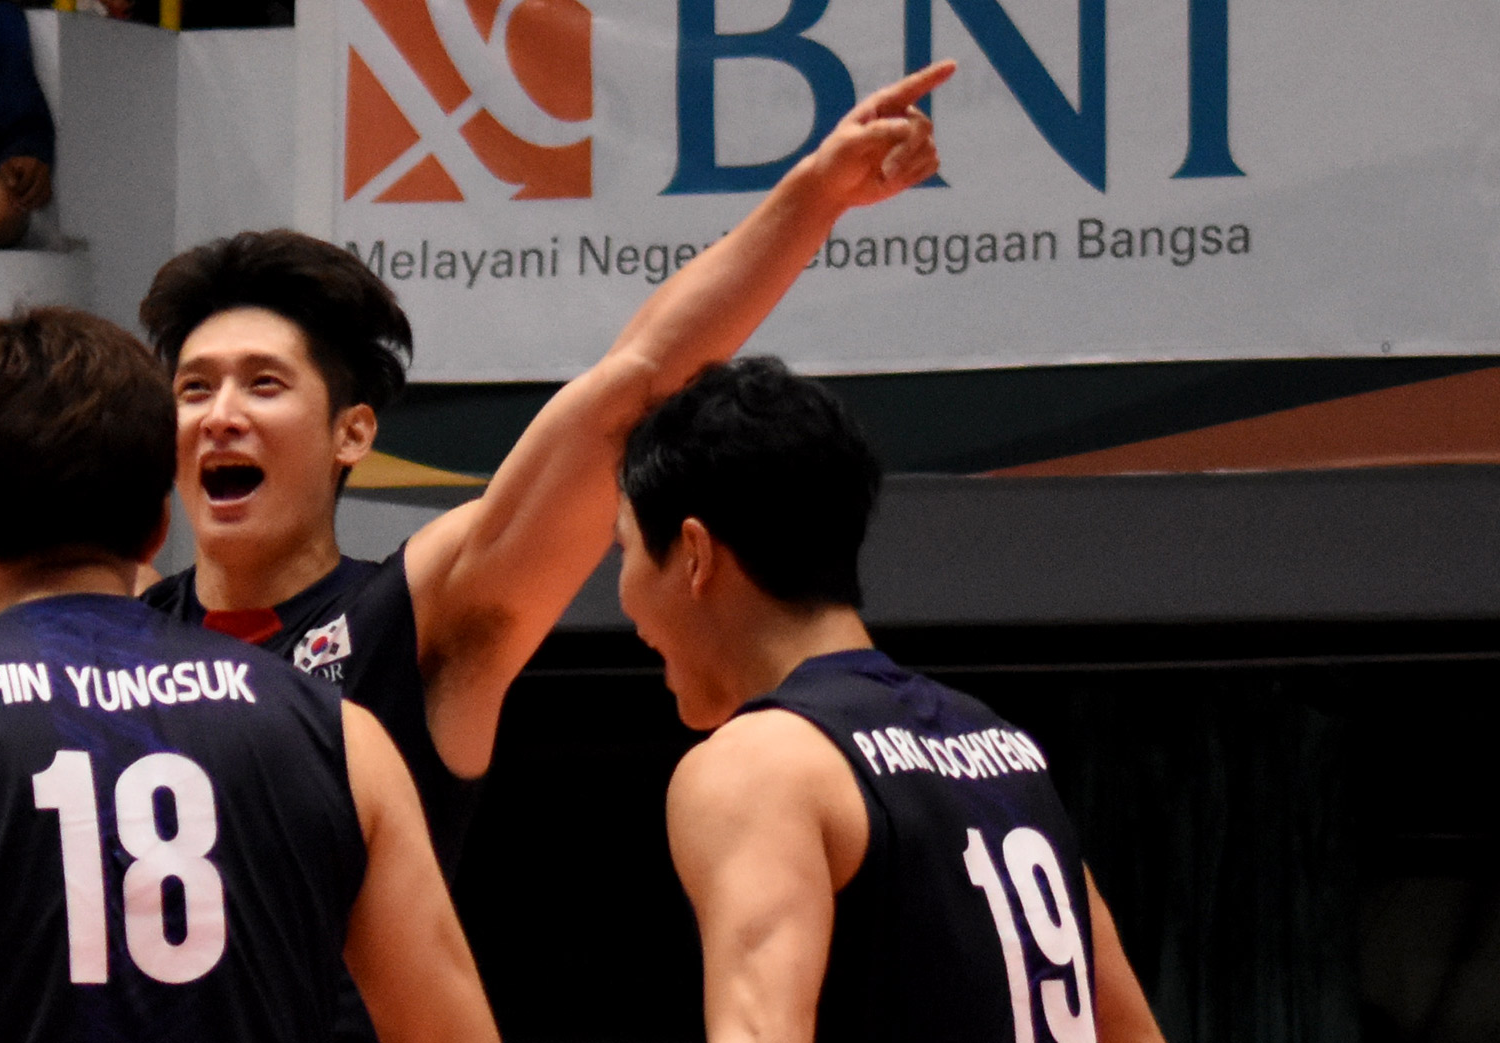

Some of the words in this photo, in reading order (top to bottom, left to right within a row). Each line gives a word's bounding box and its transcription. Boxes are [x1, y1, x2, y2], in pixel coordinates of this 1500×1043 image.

[658, 0, 1247, 194] BNI
[345, 234, 560, 289] Melayani
[1077, 217, 1251, 267] Bangsa
[66, 661, 256, 711] YUNGSUK
[32, 749, 227, 985] 18
